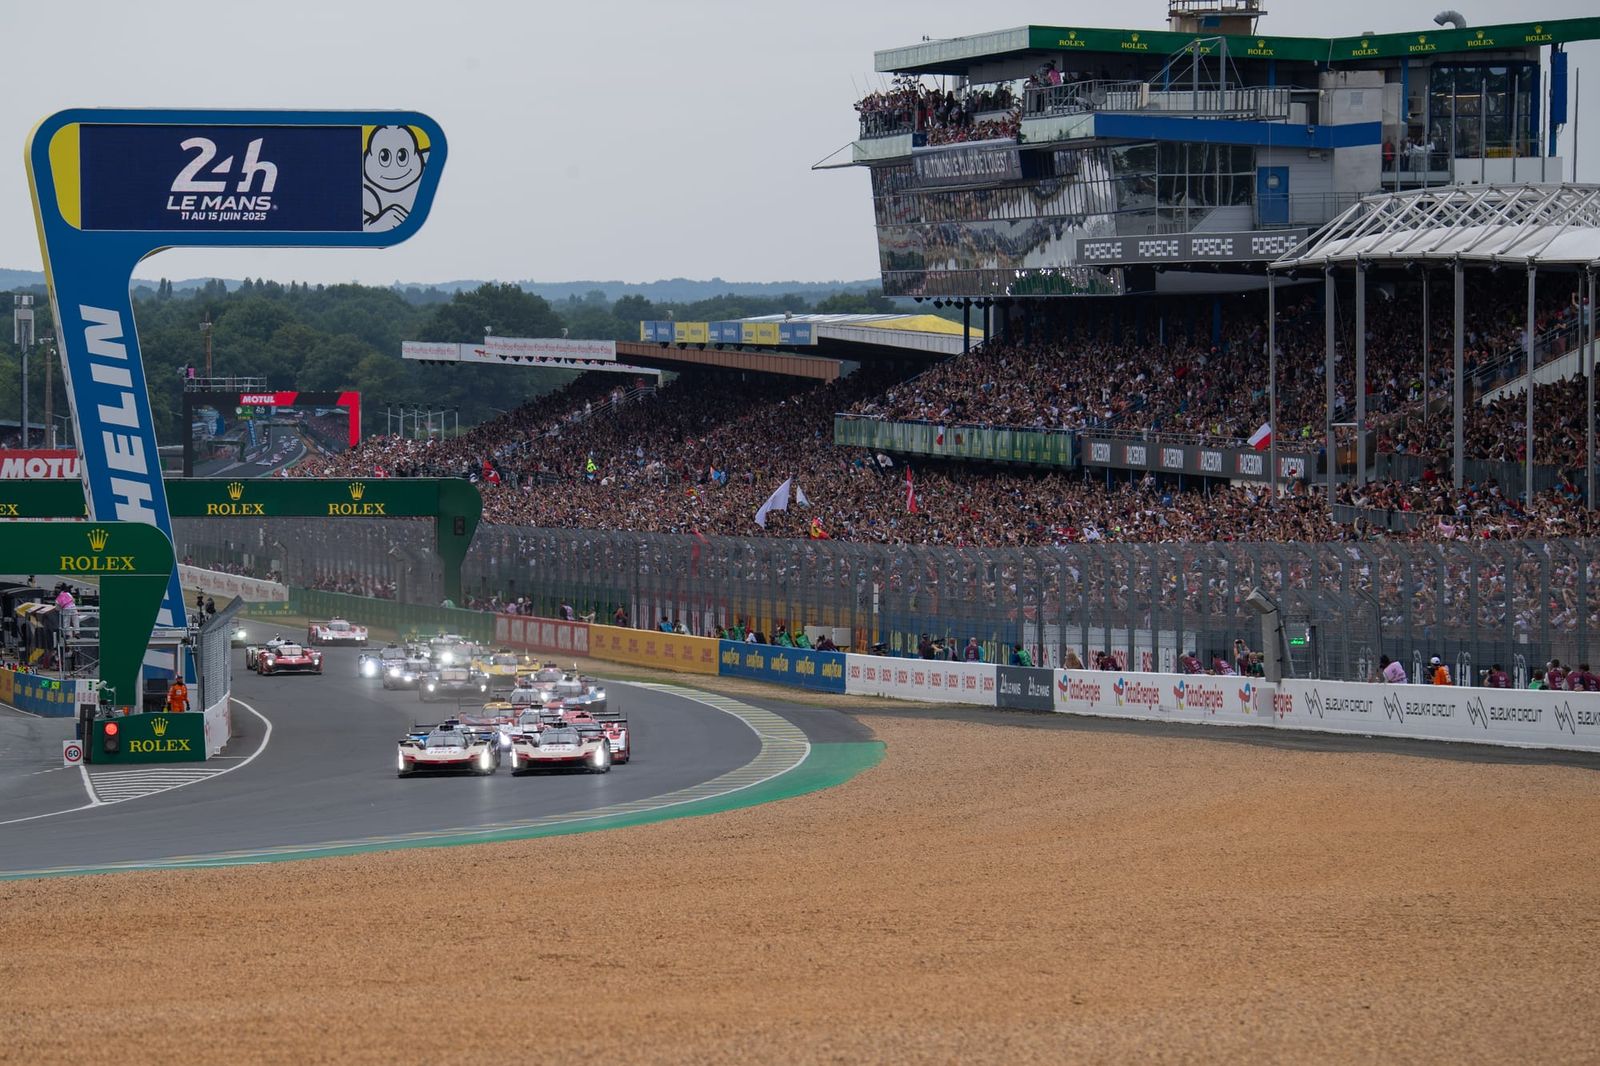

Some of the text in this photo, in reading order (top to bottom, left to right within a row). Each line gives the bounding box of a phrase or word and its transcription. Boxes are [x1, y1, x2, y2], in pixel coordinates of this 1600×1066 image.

[1059, 39, 1085, 47] ROLEX
[1467, 39, 1494, 47] ROLEX
[1526, 34, 1552, 42] ROLEX
[1121, 42, 1148, 50] ROLEX
[1247, 48, 1273, 56] ROLEX
[1352, 48, 1378, 56] ROLEX
[1409, 44, 1436, 52] ROLEX
[171, 137, 278, 192] 24h
[167, 196, 272, 210] LE MANS
[181, 212, 266, 222] 11 AU 15 JUIN 2025
[1084, 242, 1122, 259] PORSCHE
[1139, 240, 1179, 257] PORSCHE
[1191, 238, 1233, 255] PORSCHE
[1252, 235, 1297, 254] PORSCHE
[242, 395, 275, 403] MOTUL
[1, 458, 79, 478] MOTU
[207, 503, 265, 515] ROLEX
[328, 503, 385, 515] ROLEX
[60, 556, 136, 571] ROLEX
[1068, 678, 1101, 706] TotalEnergies
[1125, 681, 1160, 709] TotalEnergies
[1185, 684, 1224, 714] TotalEnergies
[1350, 699, 1373, 713] CIRCUIT
[1432, 703, 1456, 717] CIRCUIT
[1518, 708, 1543, 722] CIRCUIT
[1578, 711, 1600, 725] SUZUK
[129, 739, 191, 753] ROLEX
